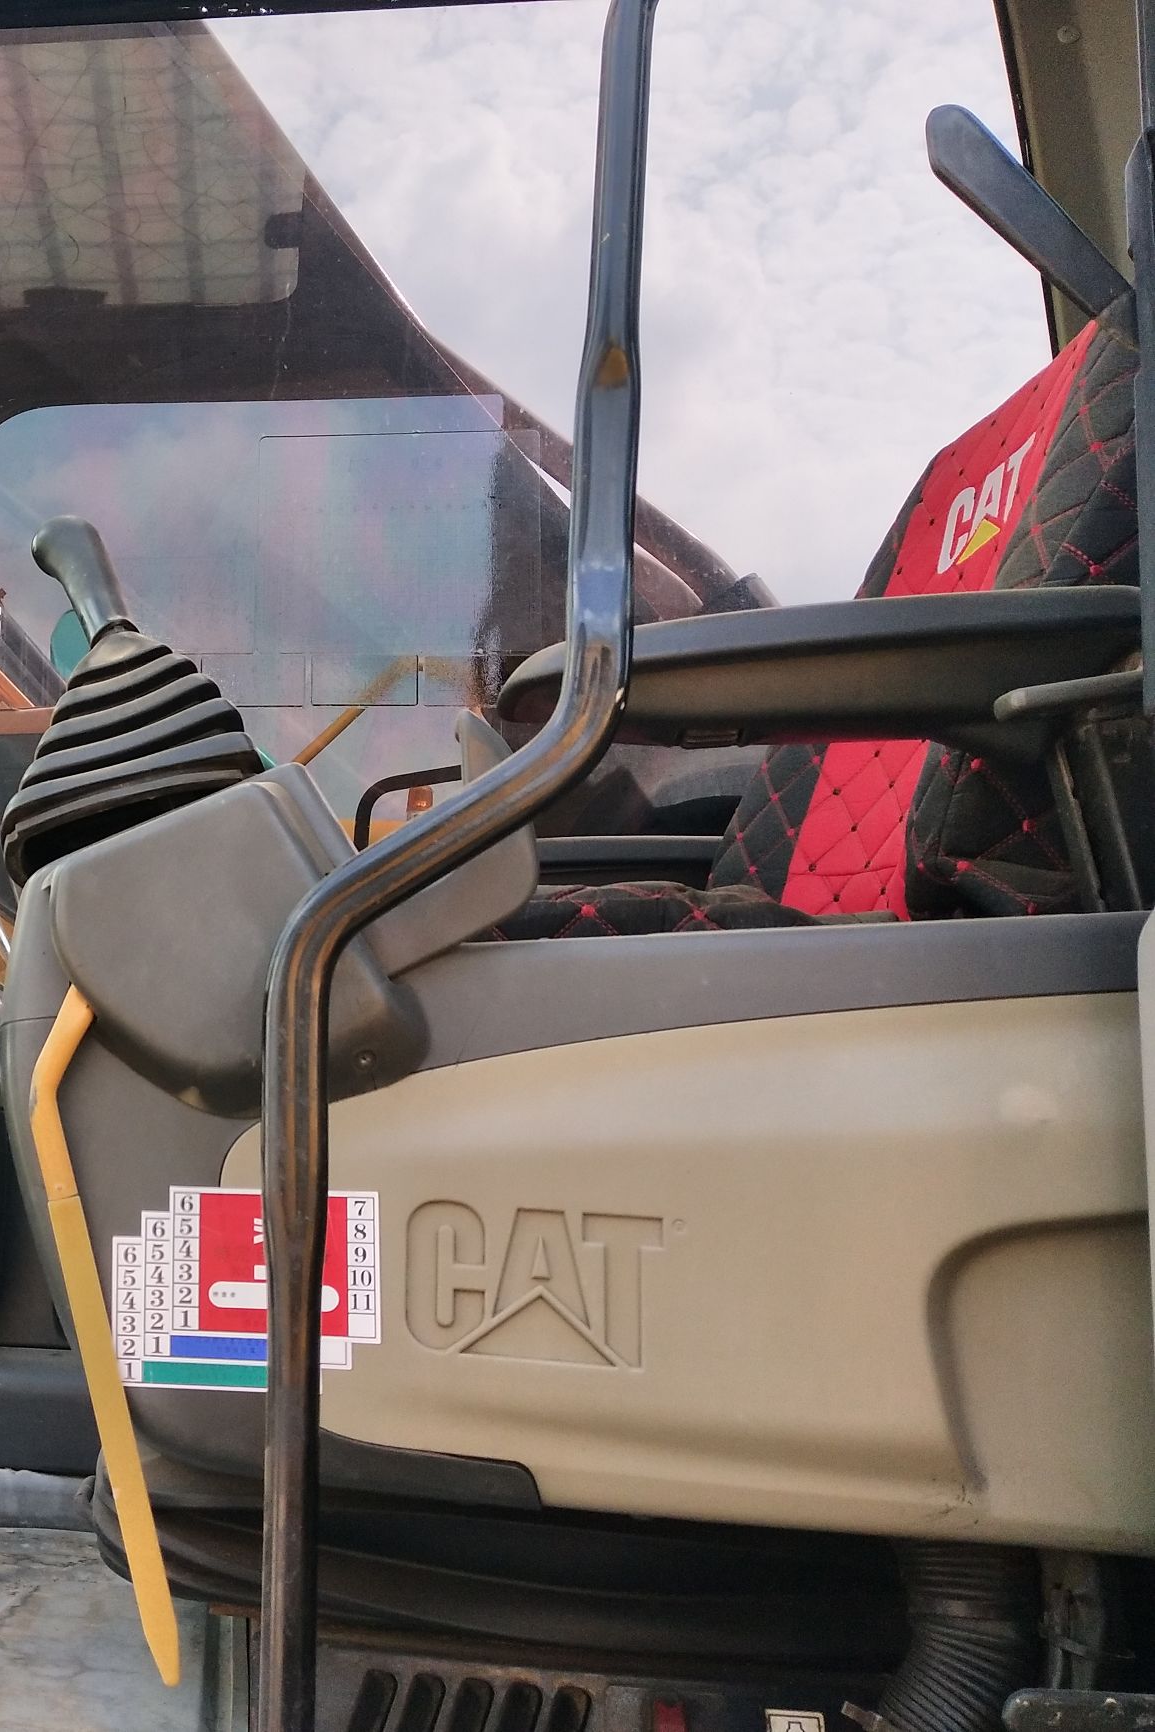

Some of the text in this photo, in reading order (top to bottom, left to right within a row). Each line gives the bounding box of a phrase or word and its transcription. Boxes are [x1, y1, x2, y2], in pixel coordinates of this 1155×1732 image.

[937, 432, 1036, 574] CAT
[179, 1194, 194, 1213] 6
[353, 1200, 367, 1217] 7
[151, 1220, 166, 1238] 6
[179, 1217, 193, 1236] 5
[353, 1223, 367, 1240] 8
[123, 1246, 137, 1264] 6
[150, 1243, 165, 1261] 5
[178, 1239, 193, 1259] 4
[354, 1246, 367, 1263] 9
[122, 1269, 136, 1287] 5
[150, 1265, 165, 1285] 4
[178, 1263, 193, 1282] 3
[351, 1269, 372, 1287] 10
[404, 1198, 664, 1371] CAT
[121, 1291, 136, 1311] 4
[150, 1289, 165, 1308] 3
[178, 1286, 193, 1305] 2
[351, 1293, 372, 1311] 11
[121, 1315, 136, 1334] 3
[150, 1312, 164, 1331] 2
[179, 1309, 191, 1328] 1
[122, 1338, 136, 1357] 2
[151, 1335, 163, 1355] 1
[123, 1362, 136, 1381] 1
